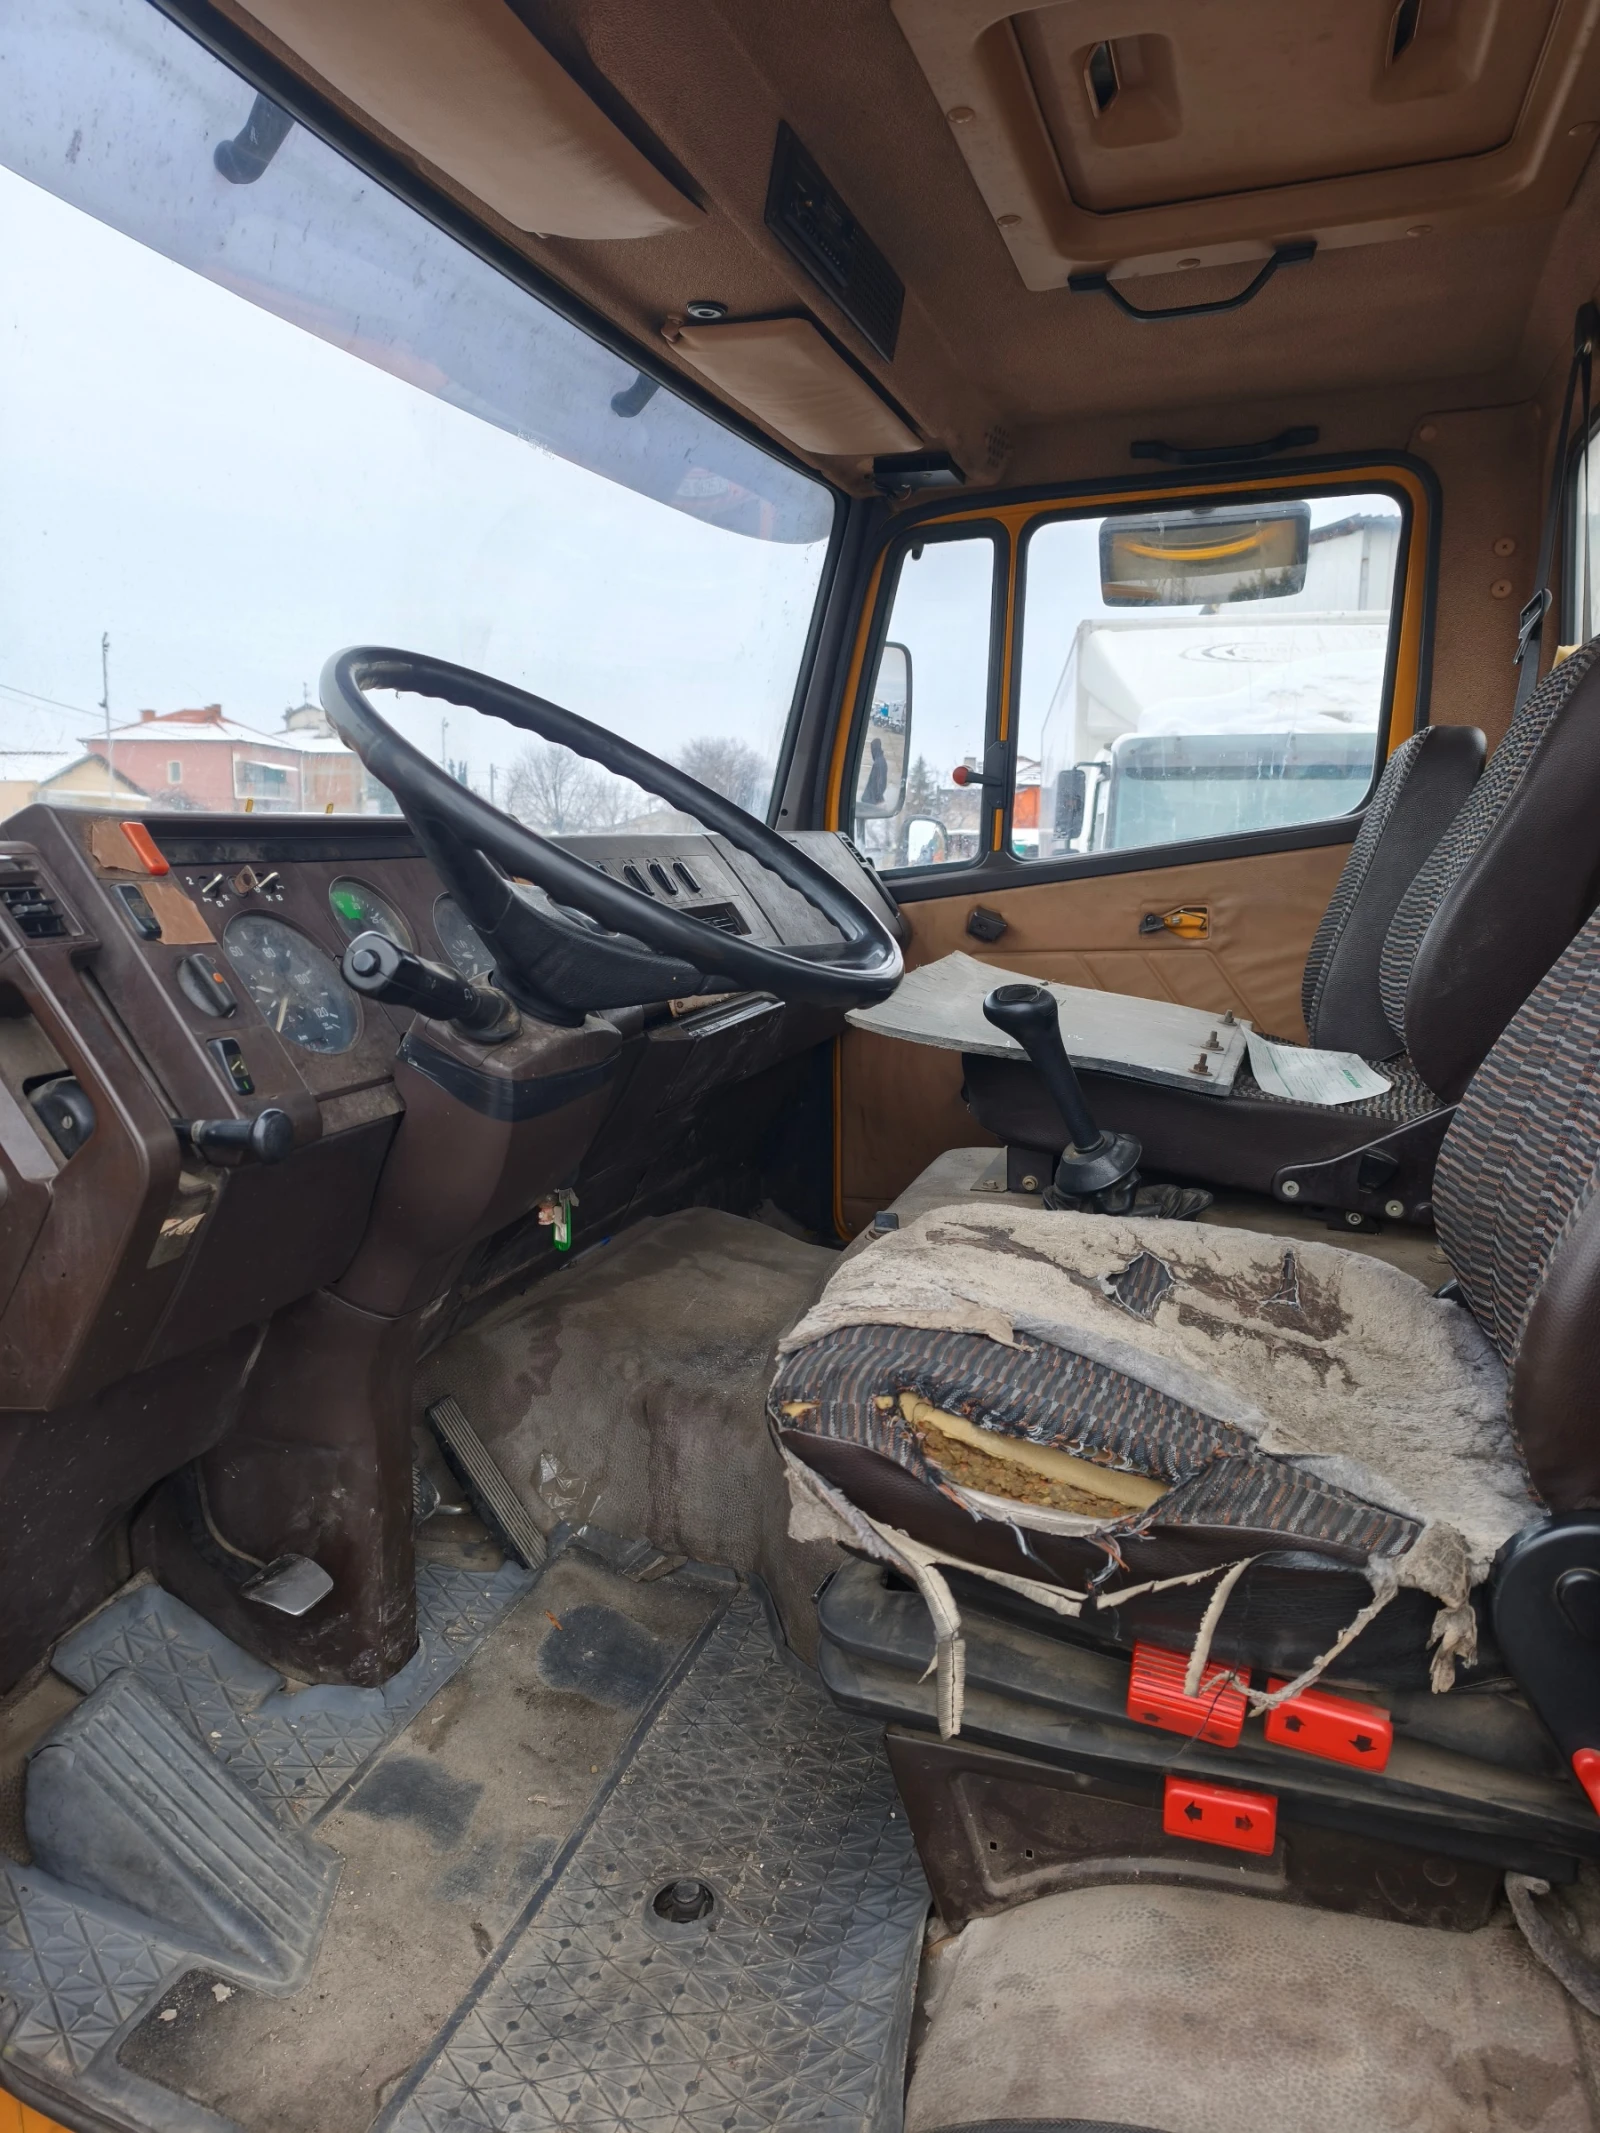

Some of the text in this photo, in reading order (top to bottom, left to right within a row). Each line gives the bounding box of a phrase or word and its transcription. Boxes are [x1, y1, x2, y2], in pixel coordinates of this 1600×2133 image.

[185, 876, 195, 886] 2
[229, 945, 244, 957] 60
[262, 946, 276, 958] 80
[294, 972, 311, 985] 100
[313, 1006, 329, 1018] 120
